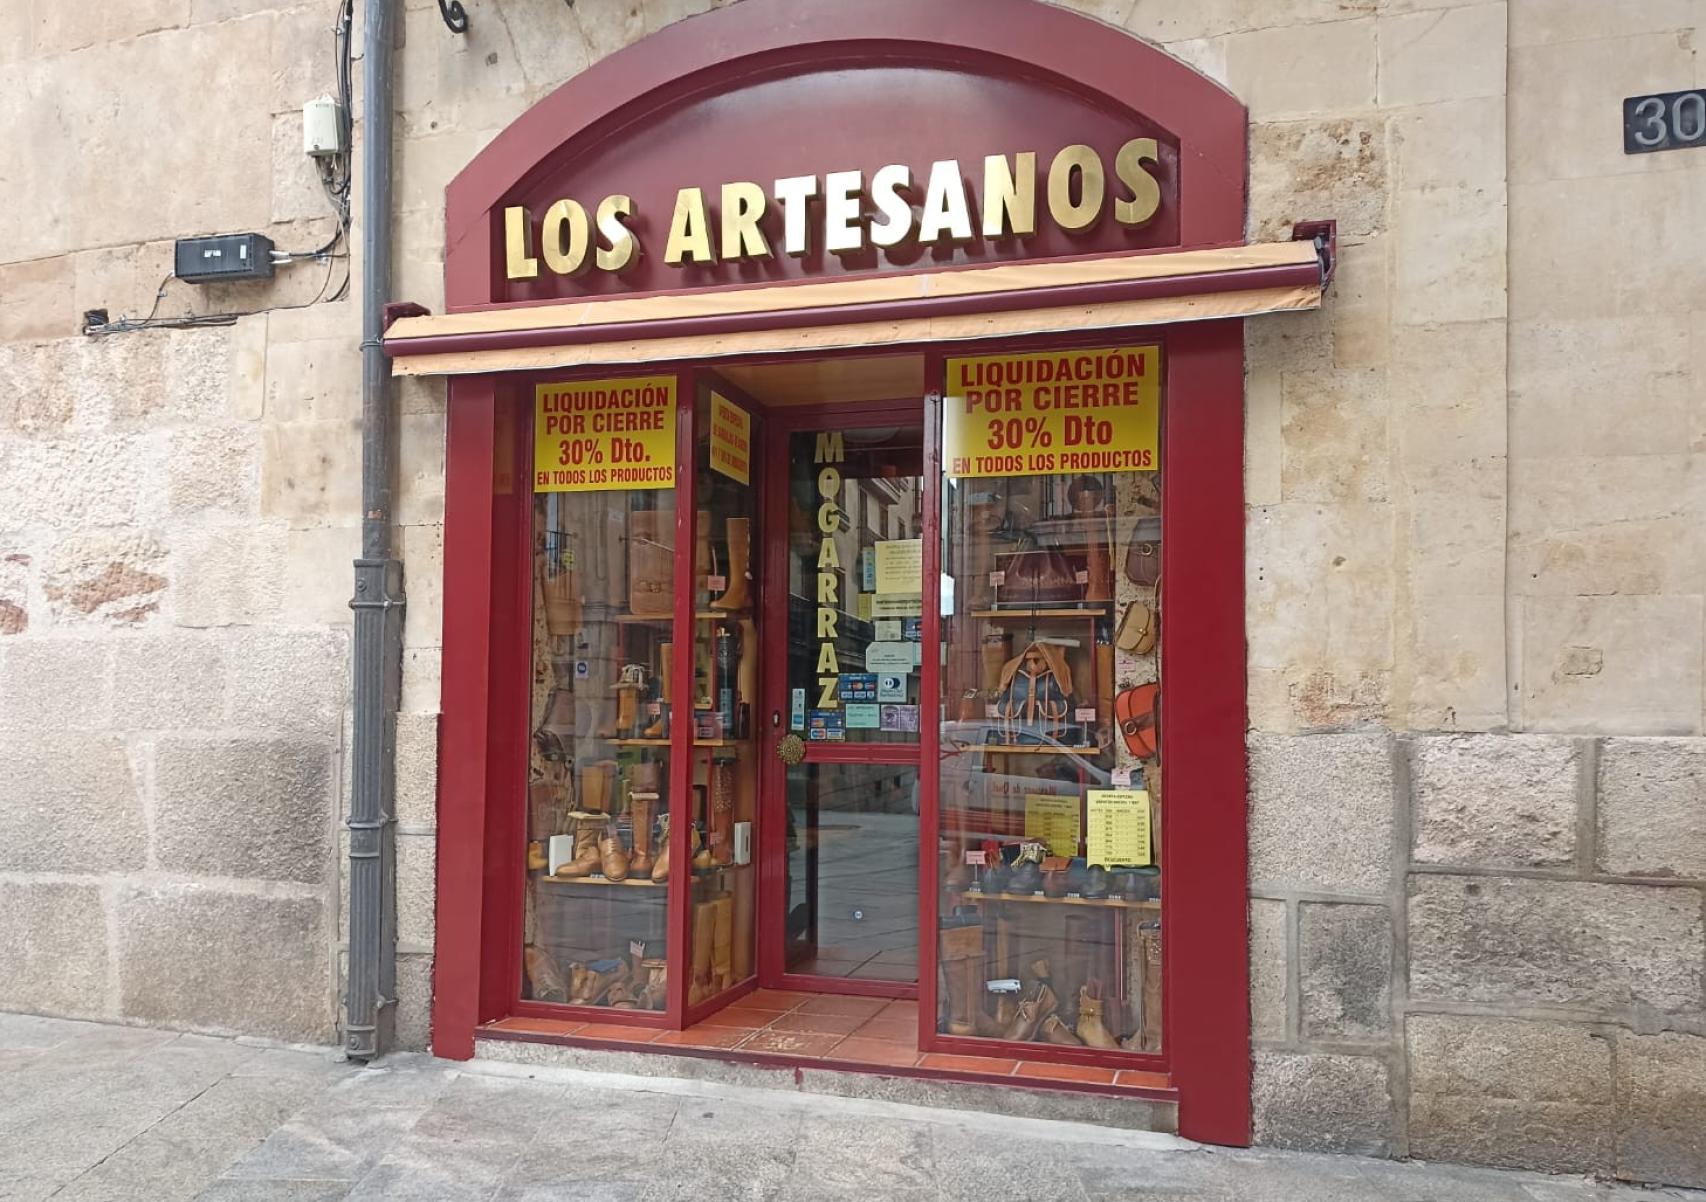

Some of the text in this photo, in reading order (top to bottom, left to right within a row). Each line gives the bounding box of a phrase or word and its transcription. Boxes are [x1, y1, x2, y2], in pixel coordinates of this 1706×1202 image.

[1635, 93, 1705, 145] 30
[505, 137, 1161, 280] LOS ARTESANOS
[961, 350, 1145, 387] LIQUIDACIÓN
[542, 383, 669, 414] LIQUIDACIÓN
[966, 382, 1138, 414] POR CIERRE
[546, 410, 664, 435] POR CIERRE
[987, 415, 1113, 450] 30% Dto
[558, 437, 651, 466] 30% Dto.
[952, 450, 1152, 474] EN TODOS LOS PRODUCTOS
[537, 466, 673, 485] EN TODOS LOS PRODUCTOS
[814, 432, 845, 708] MOGARRAZ
